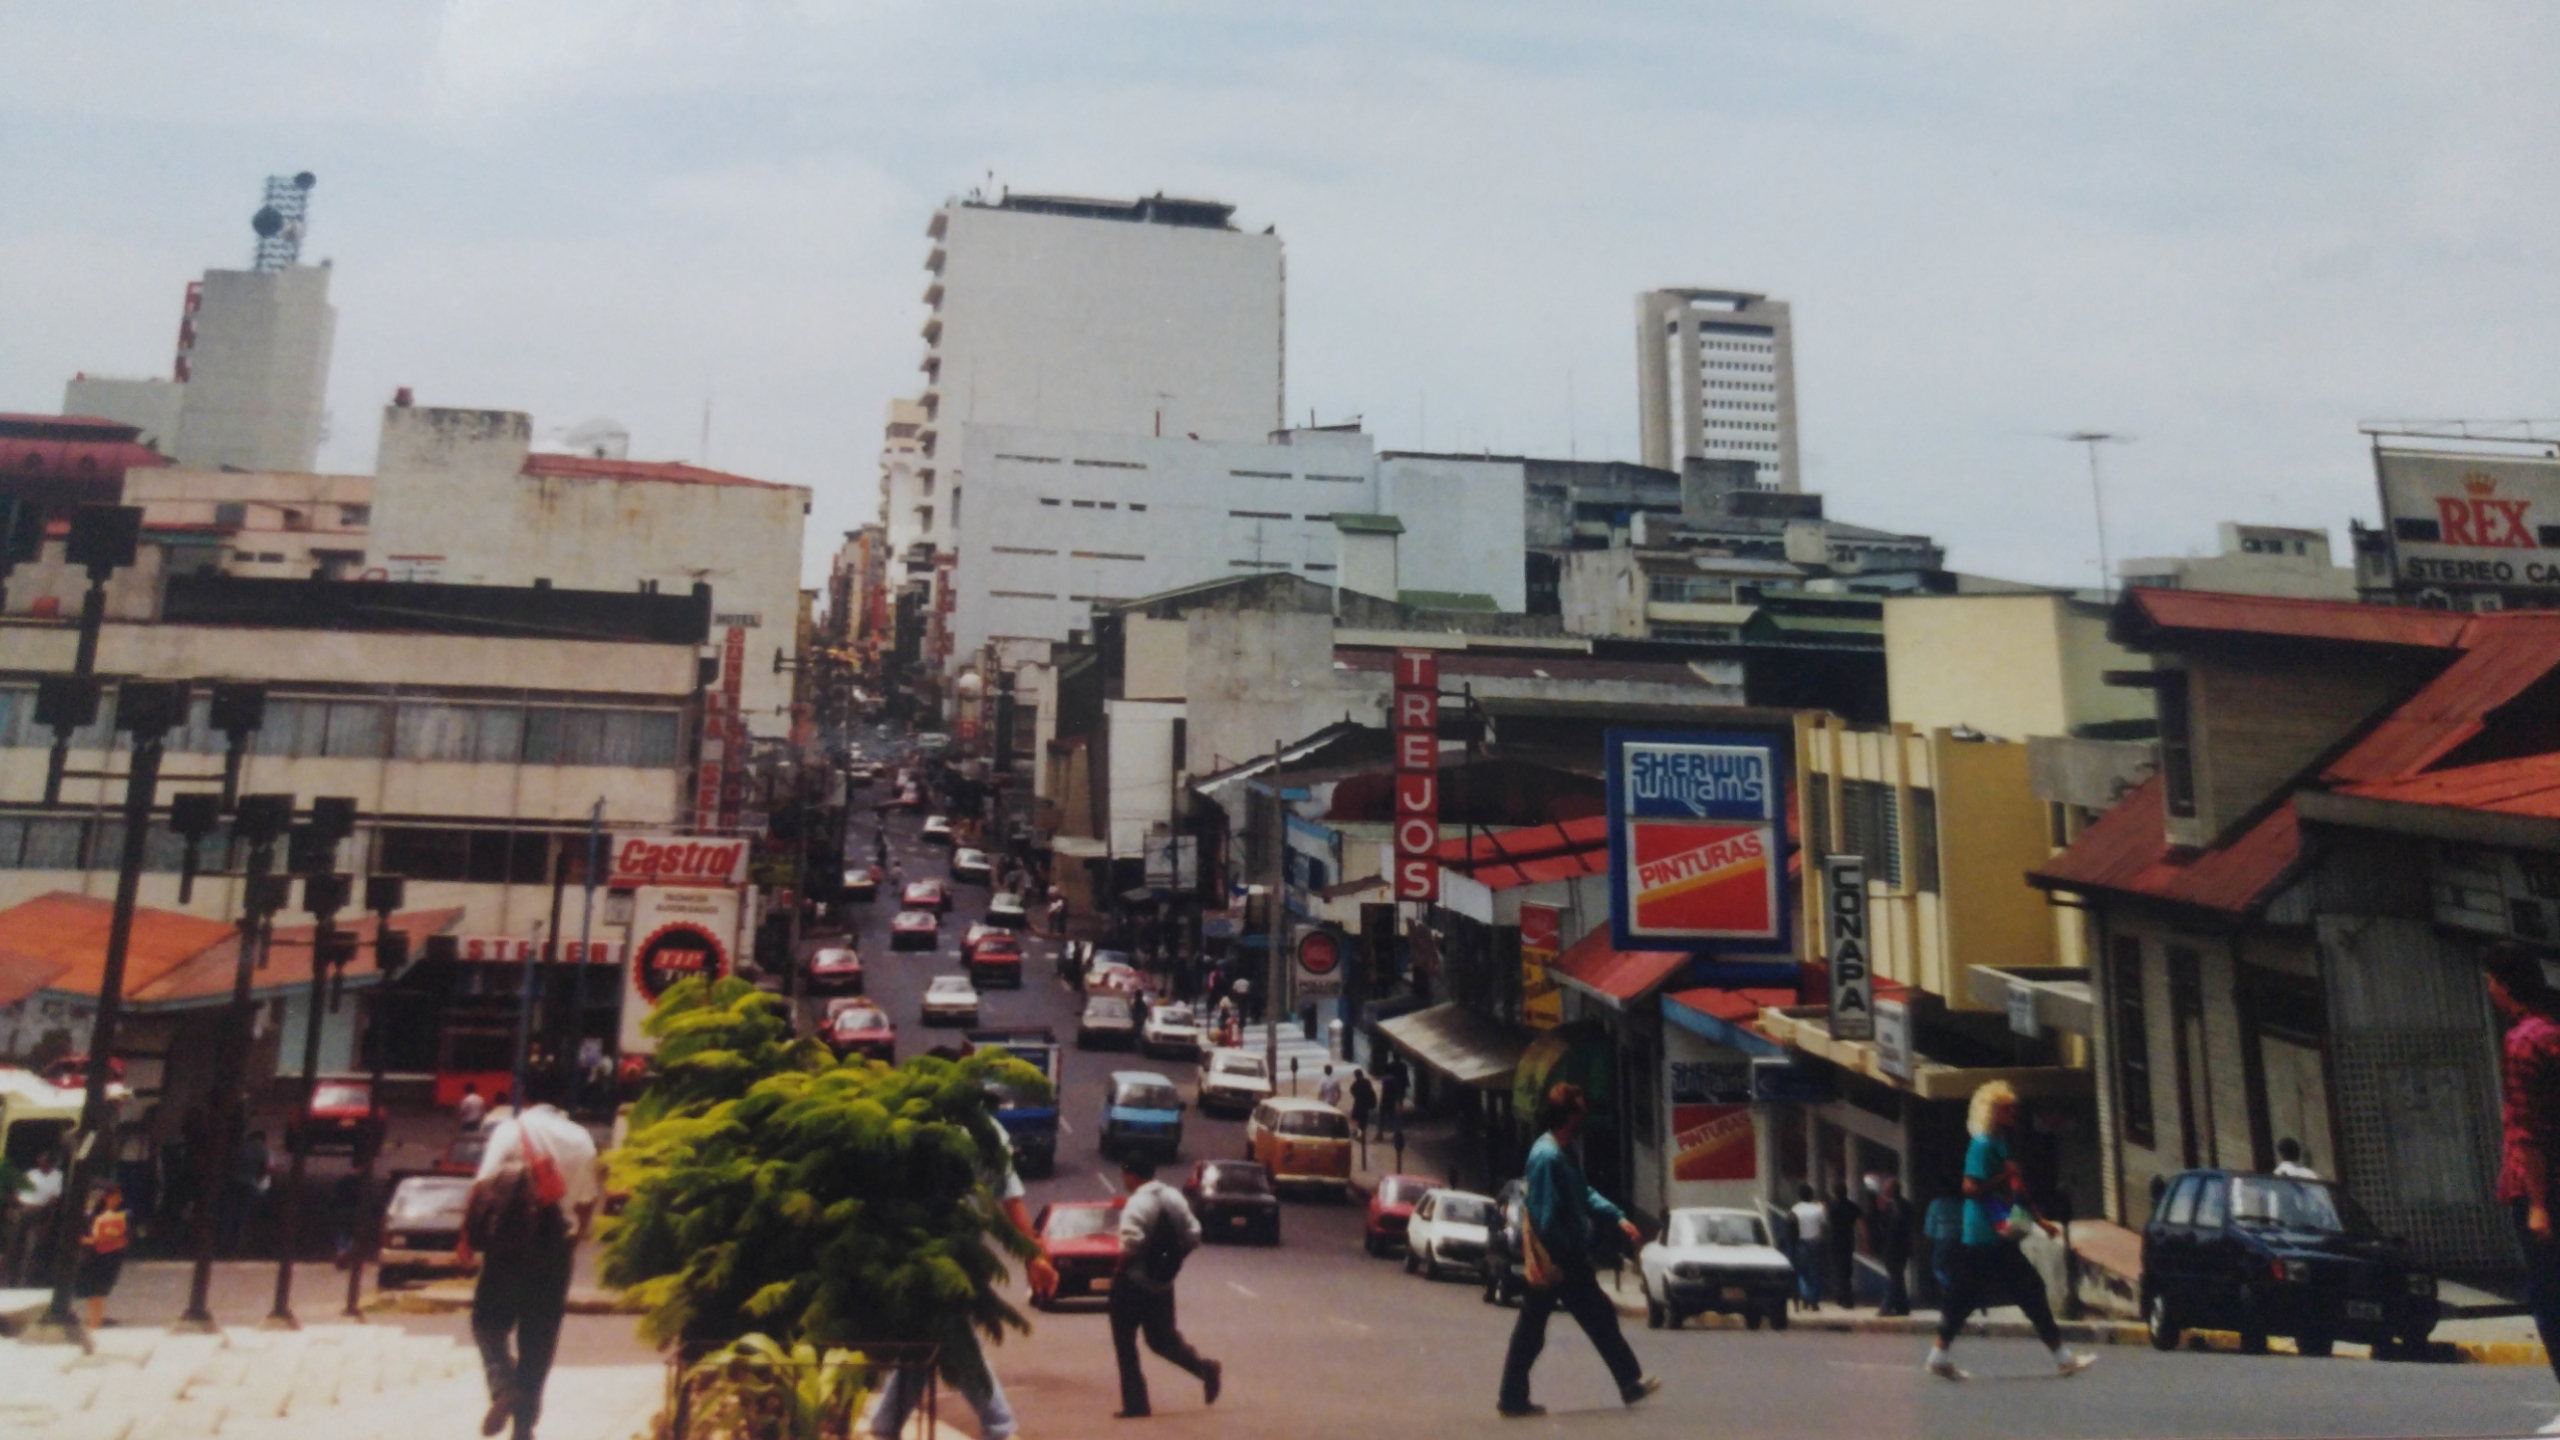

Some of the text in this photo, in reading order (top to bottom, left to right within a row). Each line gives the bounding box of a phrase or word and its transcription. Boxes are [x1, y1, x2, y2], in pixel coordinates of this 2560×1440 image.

[2436, 497, 2538, 548] REX
[2407, 557, 2513, 582] STEREO
[1401, 652, 1434, 898] TREJOS
[1633, 772, 1764, 801] Williams
[618, 838, 743, 876] Castrol
[1638, 833, 1764, 889] PINTURAS
[1831, 864, 1866, 1012] CONAPA
